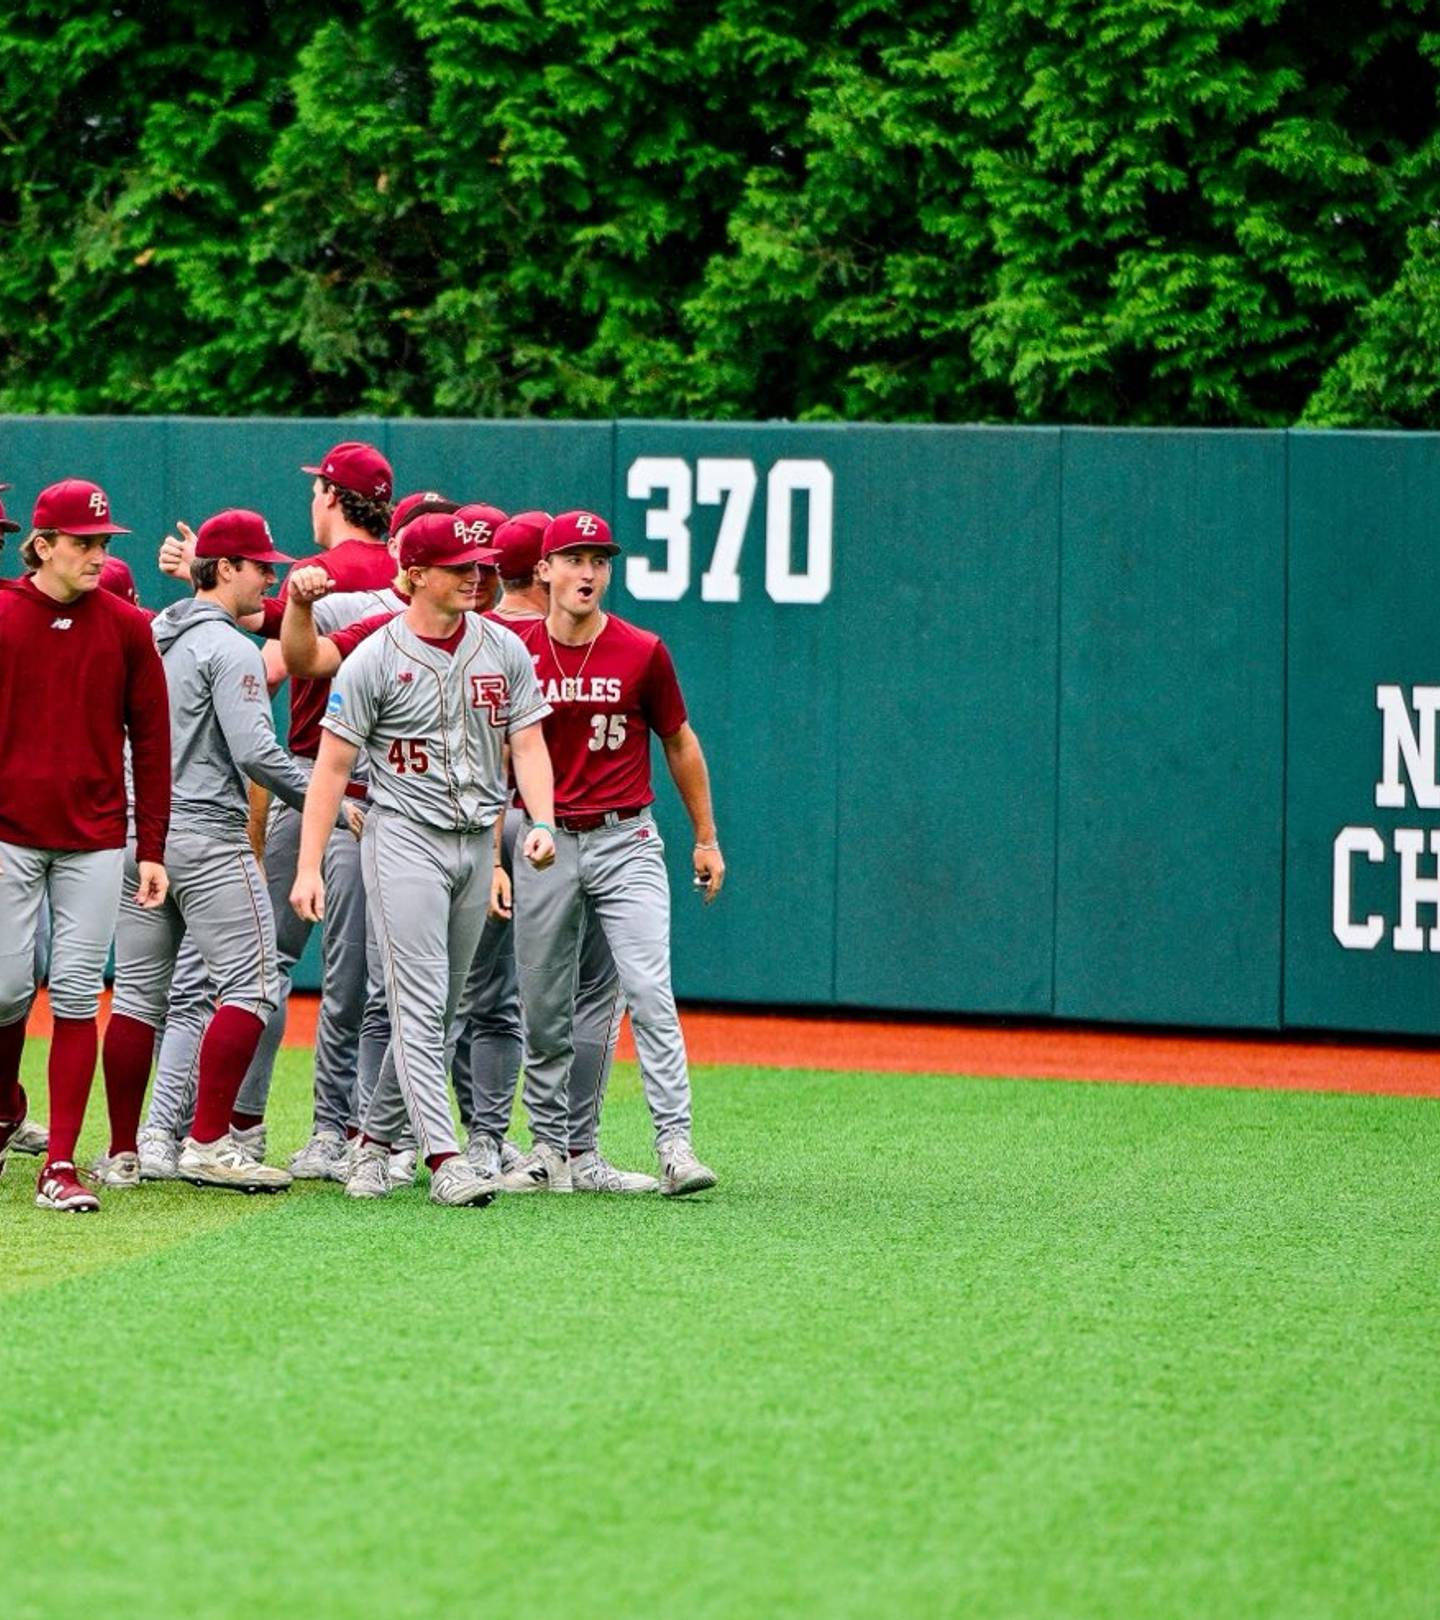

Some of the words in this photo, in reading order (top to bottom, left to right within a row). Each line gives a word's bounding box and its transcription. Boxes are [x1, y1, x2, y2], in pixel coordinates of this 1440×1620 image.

[89, 492, 108, 517] BC
[575, 515, 598, 536] BC
[625, 456, 834, 604] 370
[588, 713, 627, 752] 35
[387, 738, 429, 775] 45
[1333, 827, 1440, 952] CH
